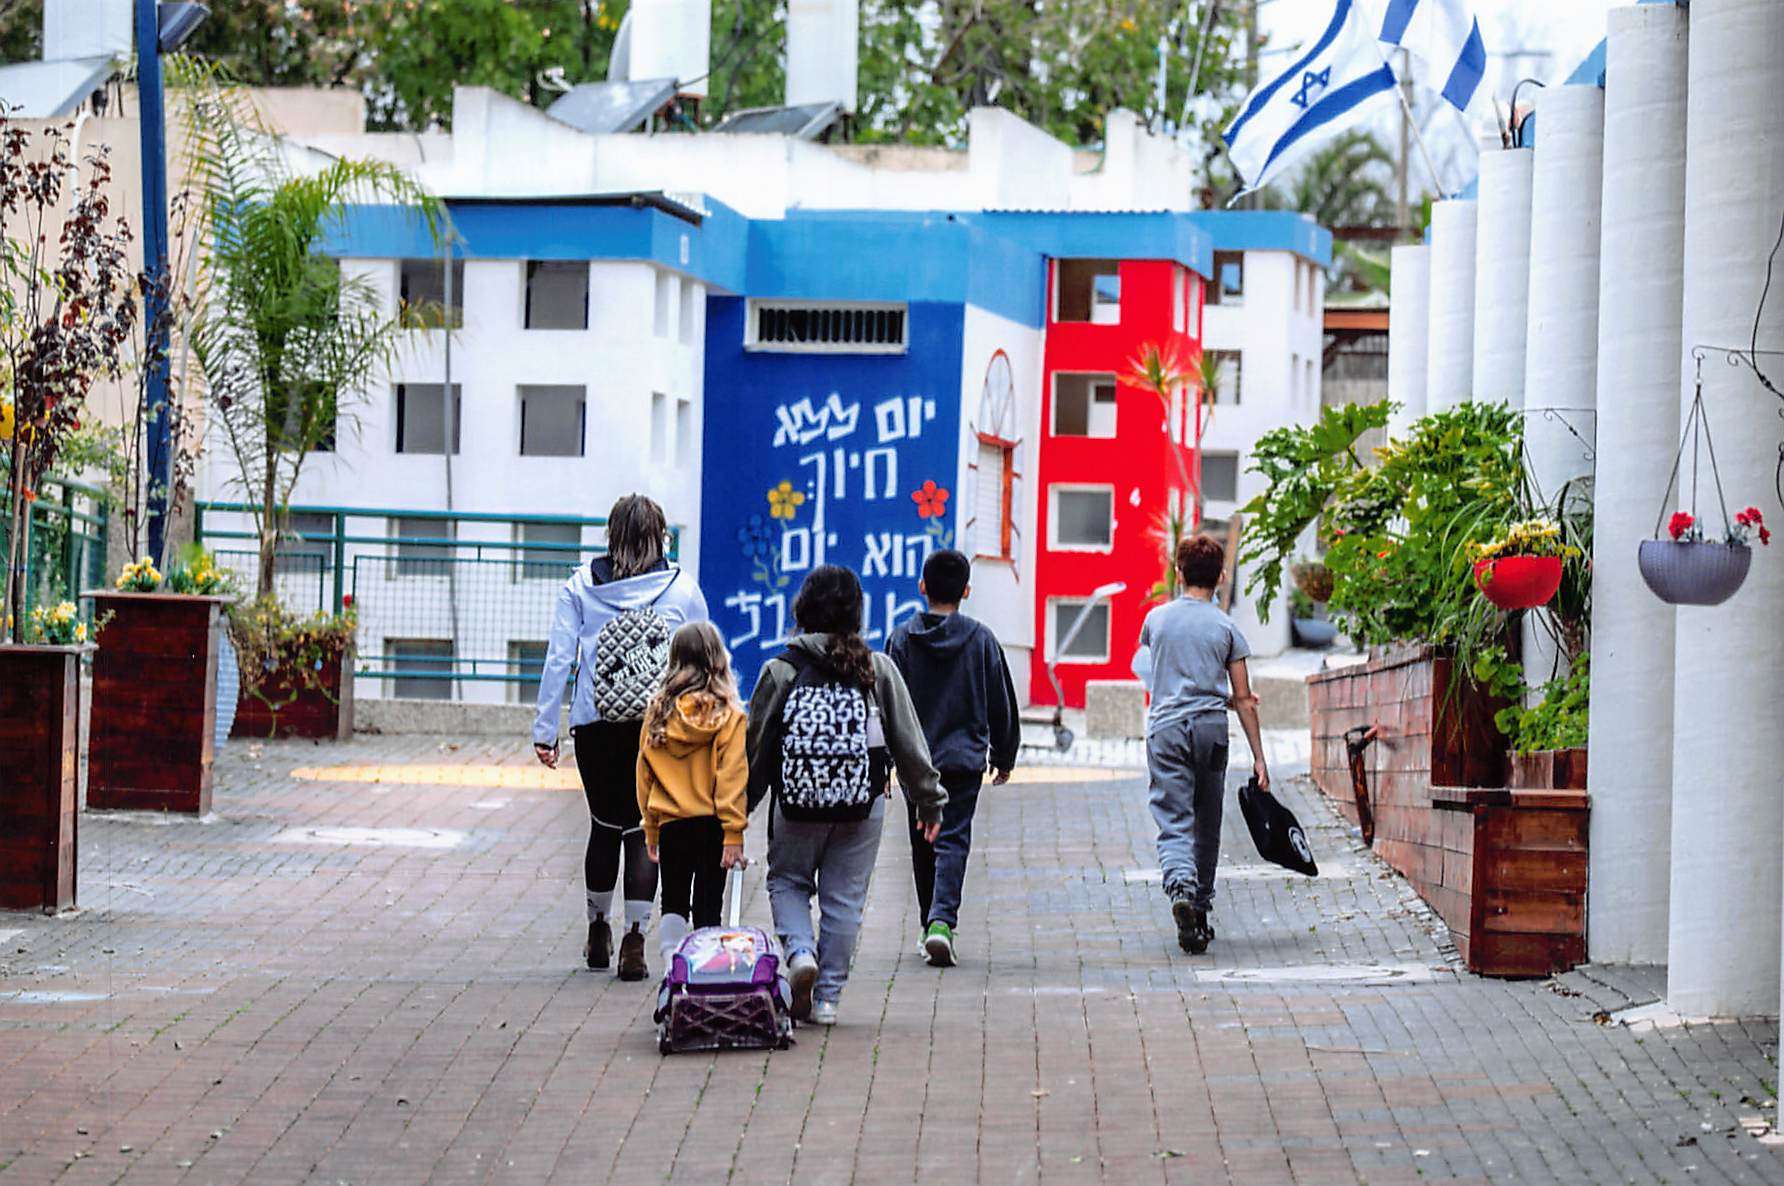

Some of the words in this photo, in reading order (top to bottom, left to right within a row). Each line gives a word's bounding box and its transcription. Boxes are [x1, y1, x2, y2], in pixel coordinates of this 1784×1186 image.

[874, 396, 936, 443] יום
[781, 528, 838, 572] יום
[862, 532, 933, 578] הוא
